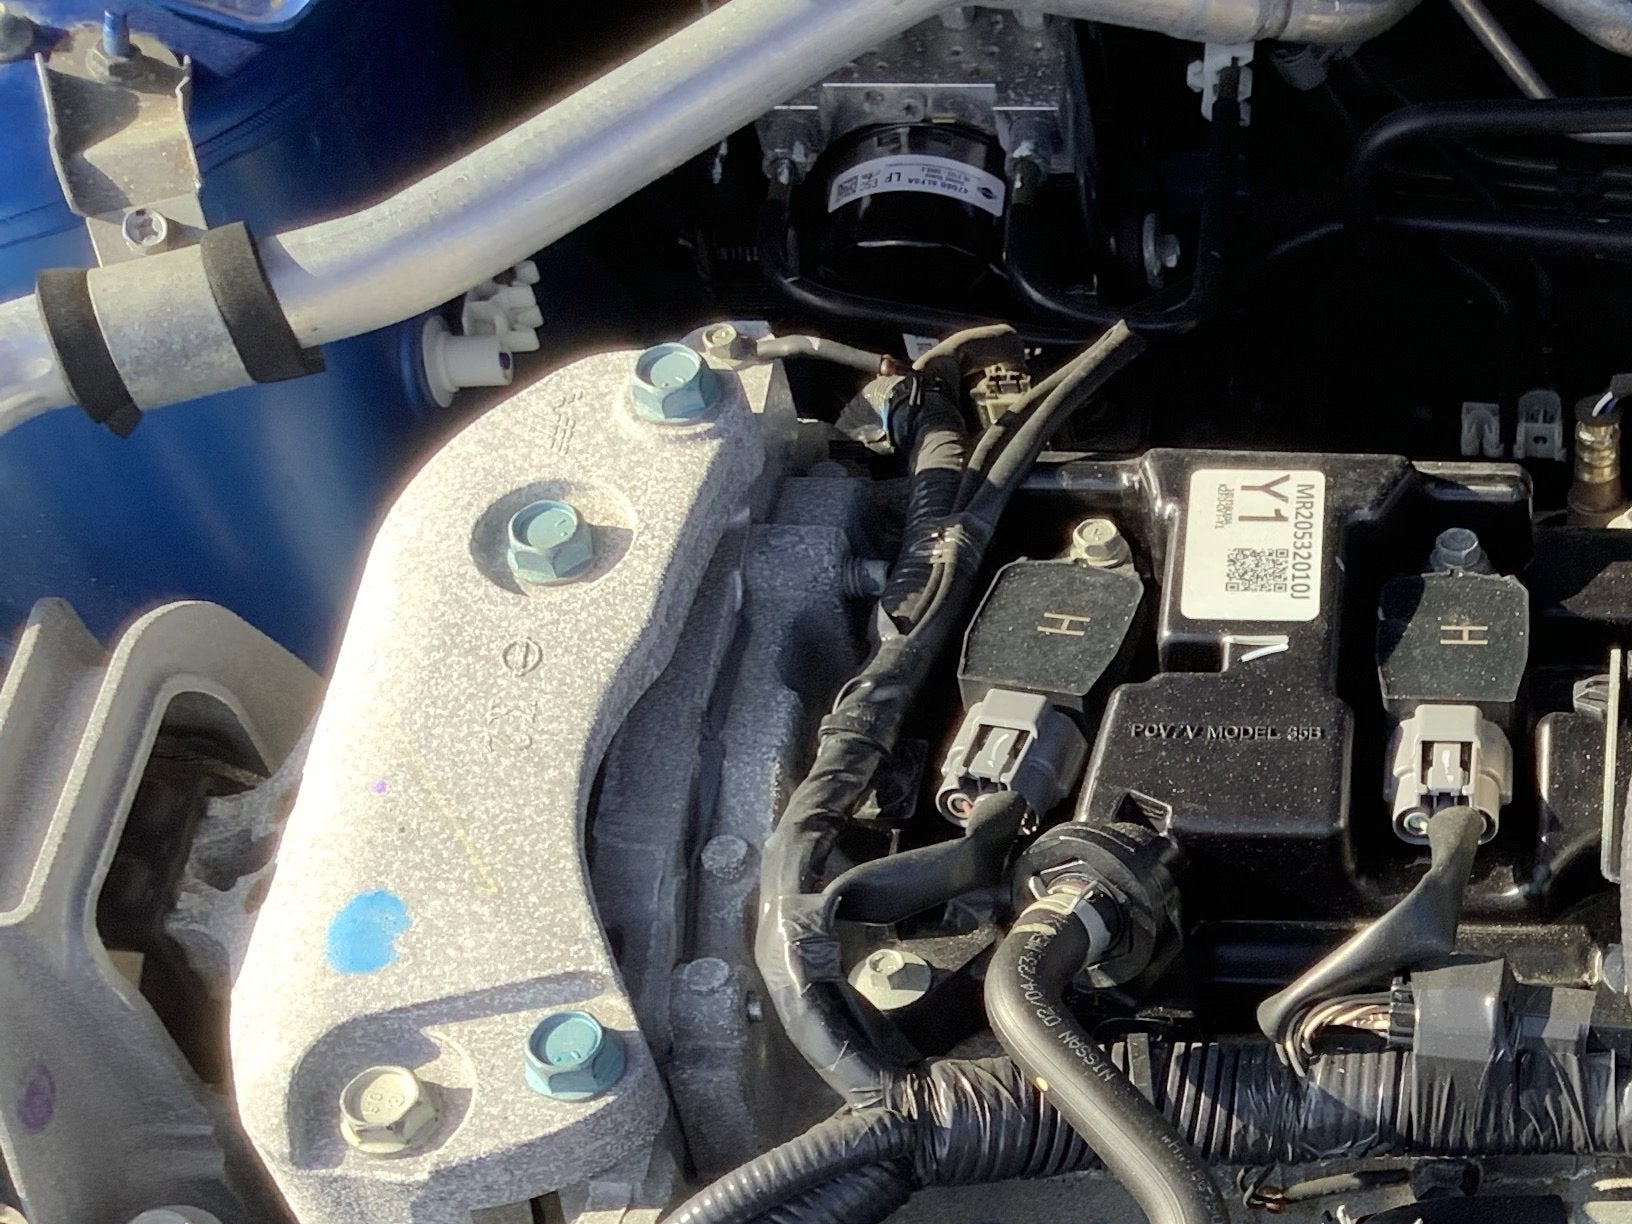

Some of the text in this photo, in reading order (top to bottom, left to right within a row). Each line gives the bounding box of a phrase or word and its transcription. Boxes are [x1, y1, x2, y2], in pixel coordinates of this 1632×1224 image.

[884, 172, 901, 183] LF
[1238, 474, 1290, 522] Y1
[1290, 484, 1315, 600] MR20532010J
[1440, 623, 1489, 647] H
[1207, 725, 1281, 740] MODEL
[1058, 1026, 1115, 1082] NISSAN
